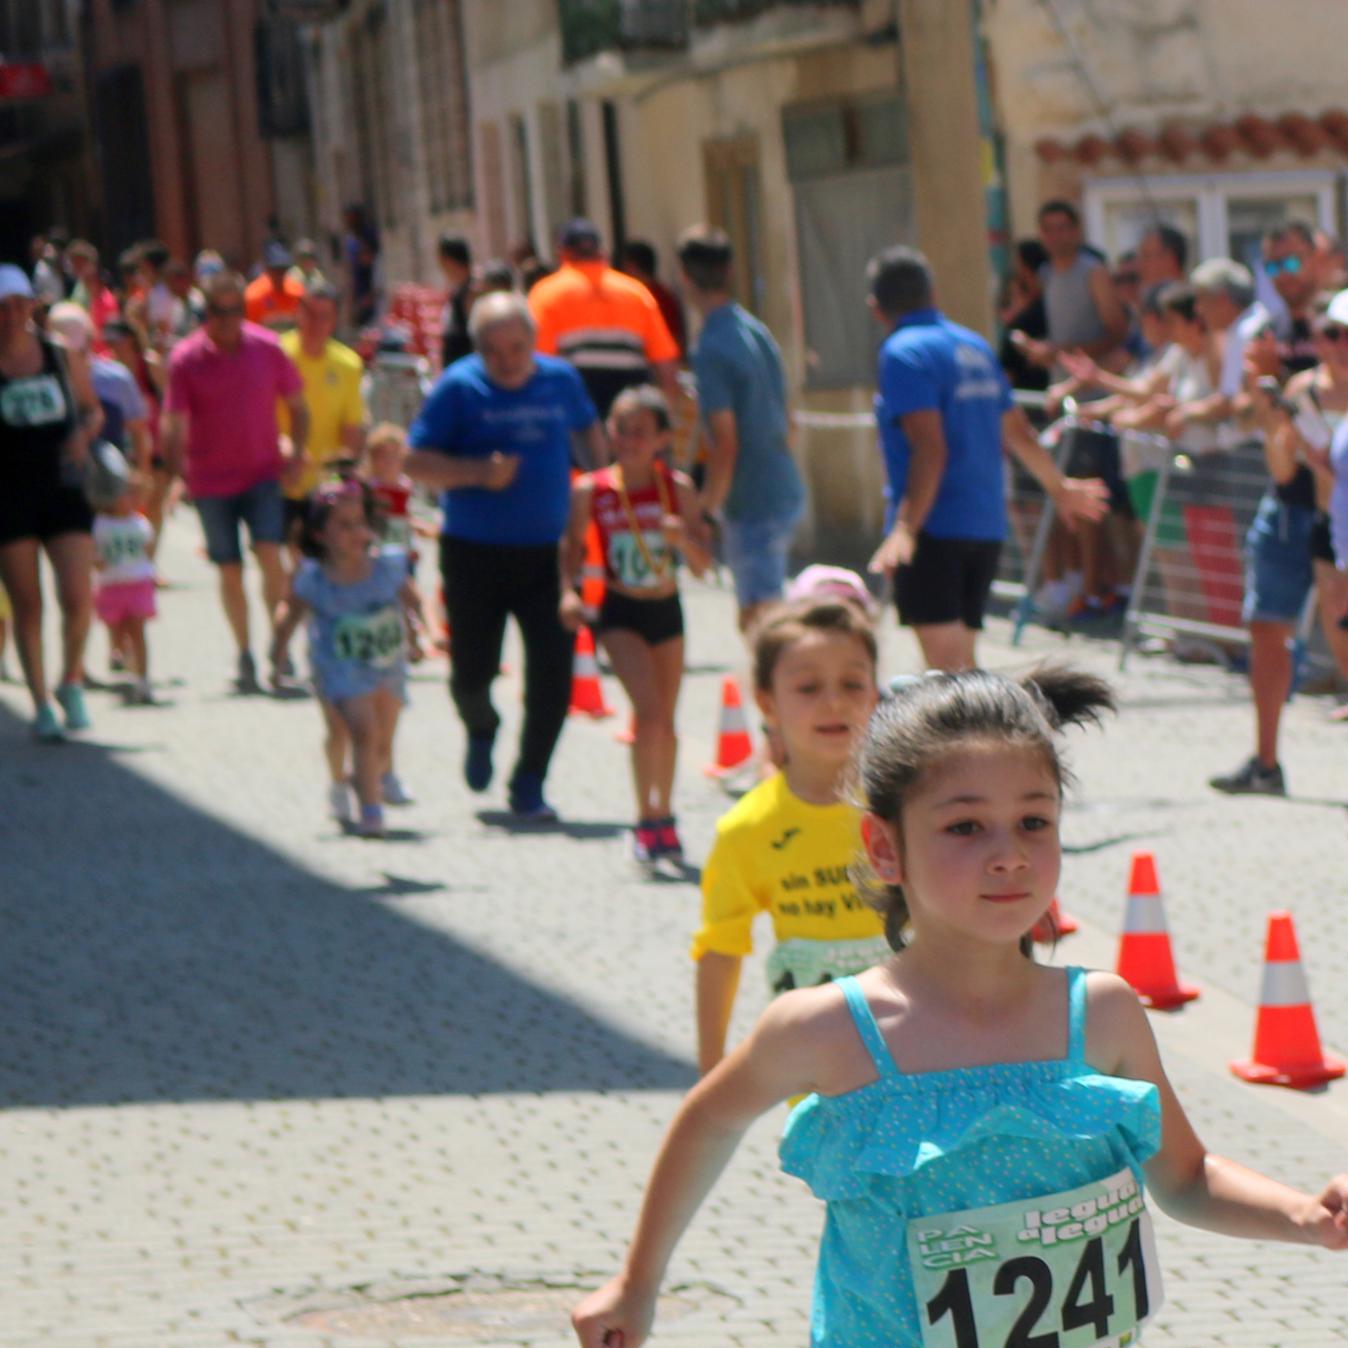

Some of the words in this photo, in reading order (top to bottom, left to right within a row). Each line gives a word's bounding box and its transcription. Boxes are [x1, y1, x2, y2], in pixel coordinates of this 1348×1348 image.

[1024, 1181, 1138, 1230] legua
[917, 1224, 978, 1243] PA
[920, 1232, 993, 1255] LEN
[922, 1248, 997, 1268] CIA
